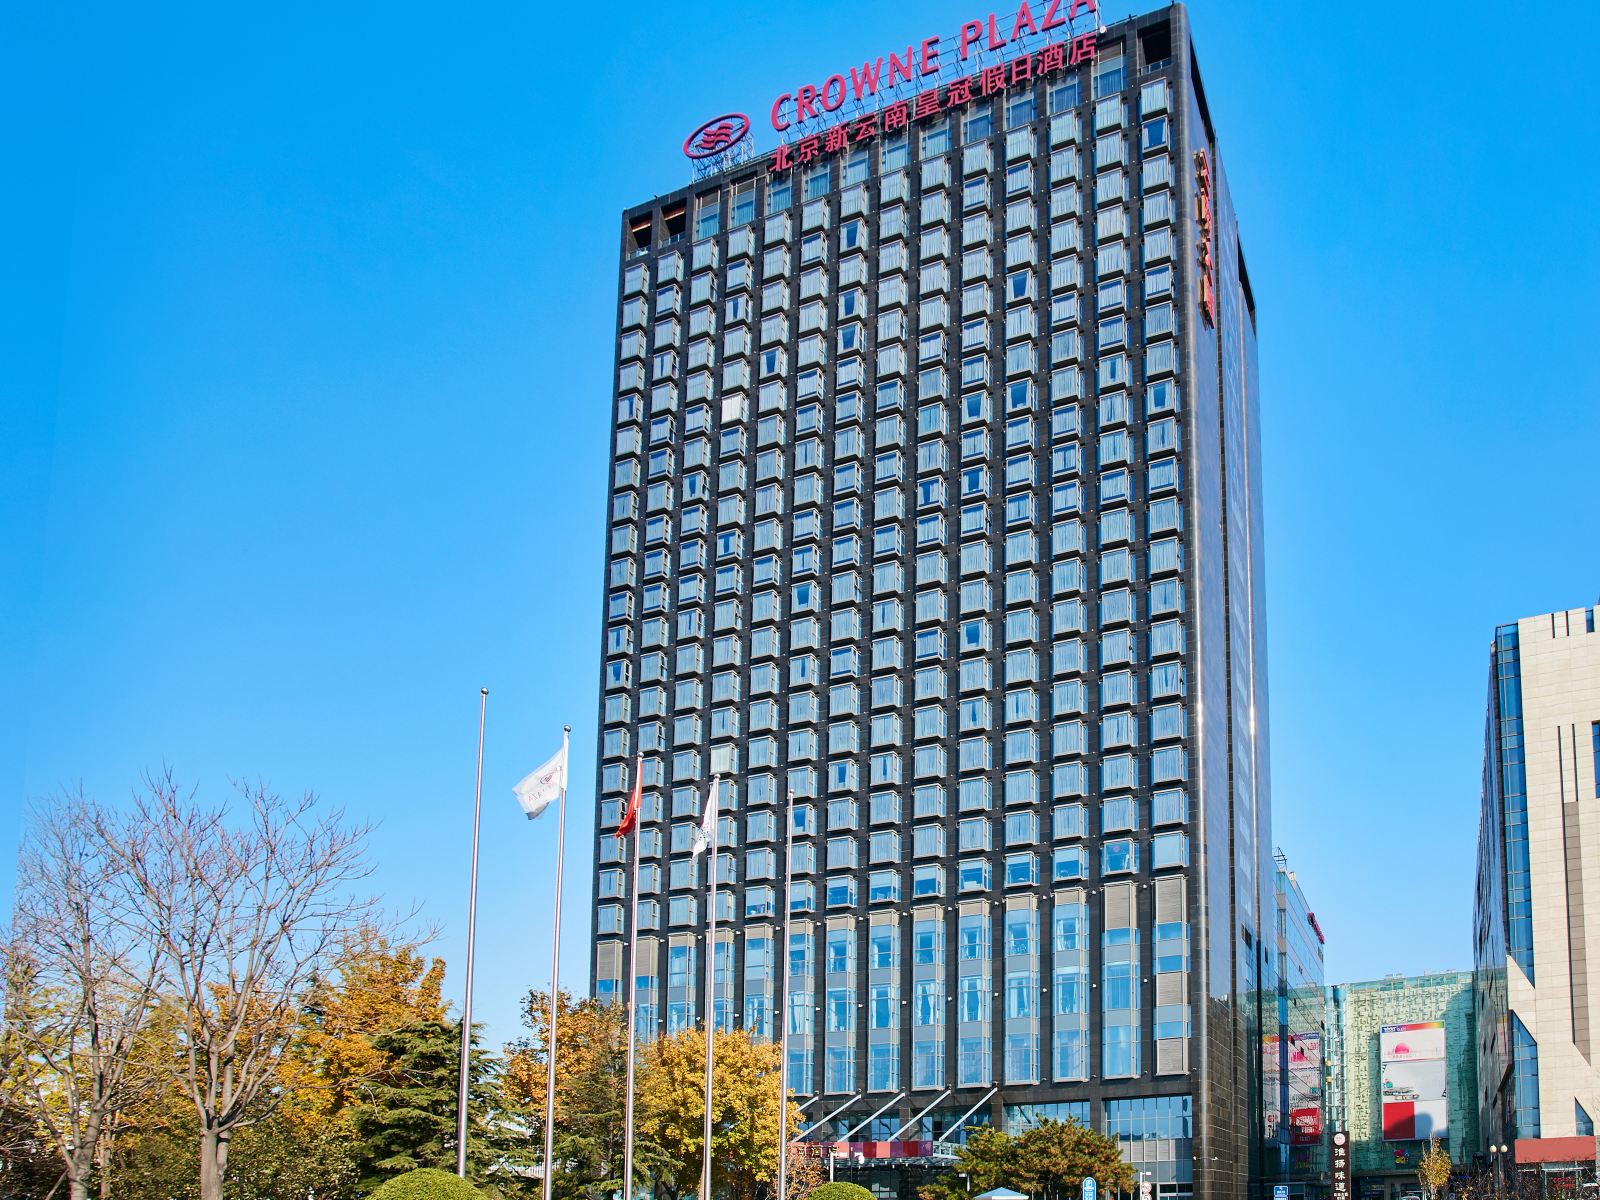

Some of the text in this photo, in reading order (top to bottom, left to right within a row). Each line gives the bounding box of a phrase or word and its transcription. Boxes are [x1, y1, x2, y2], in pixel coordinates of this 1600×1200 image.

[768, 32, 1097, 172] 北京新云南皇冠假日酒店
[771, 36, 939, 131] CROWNE
